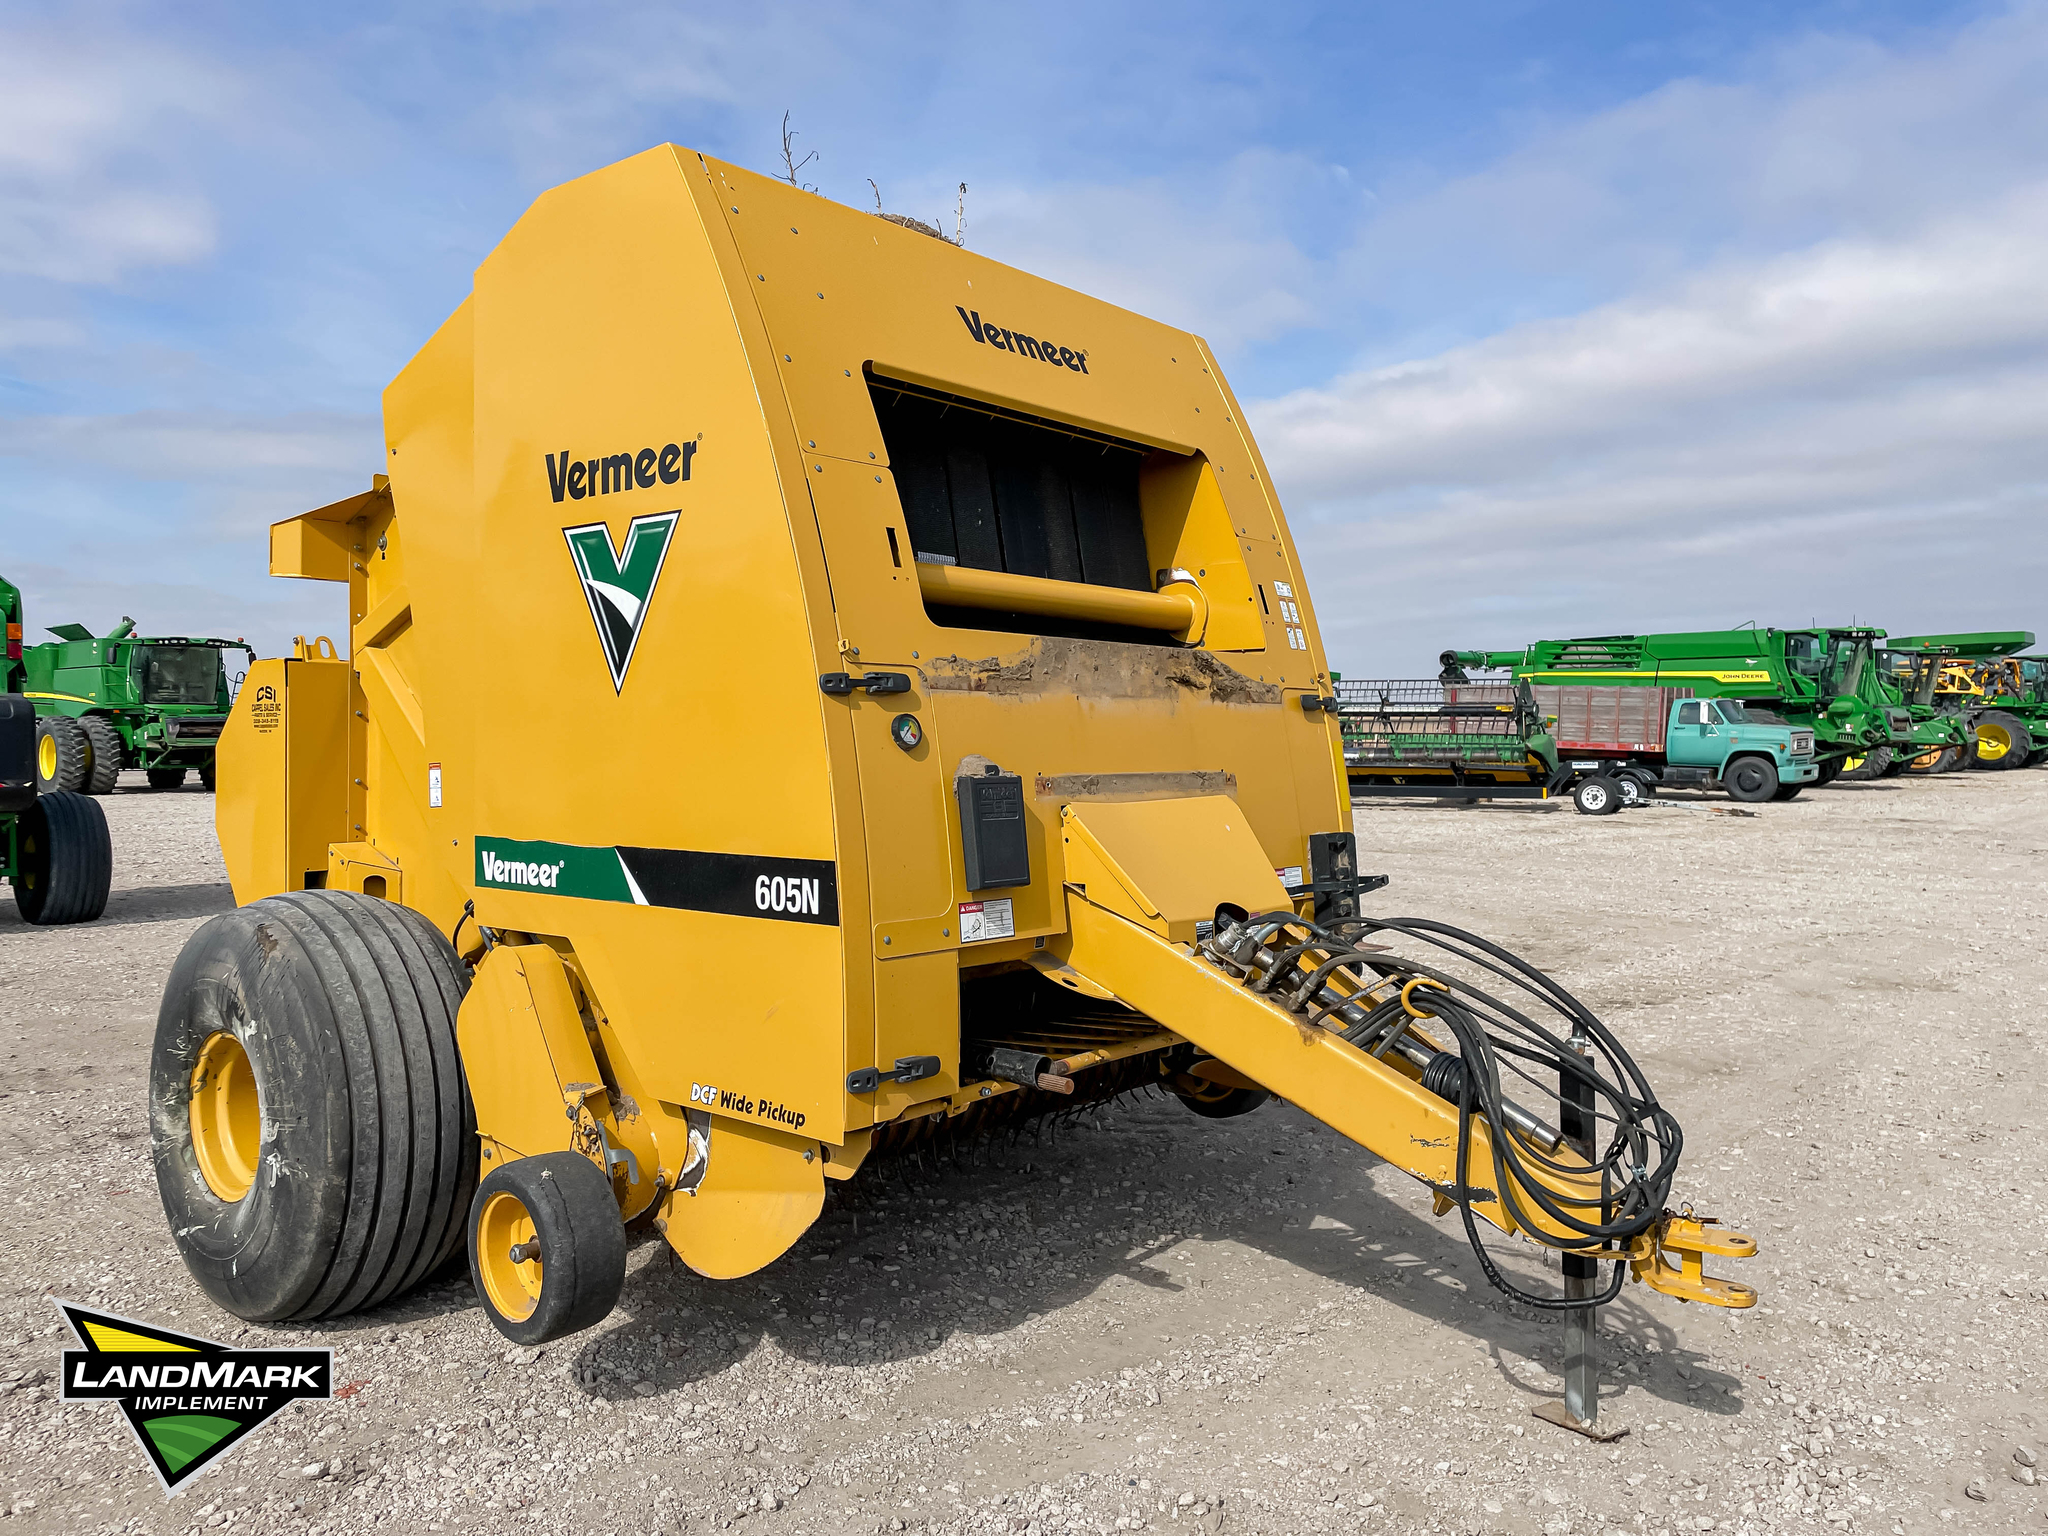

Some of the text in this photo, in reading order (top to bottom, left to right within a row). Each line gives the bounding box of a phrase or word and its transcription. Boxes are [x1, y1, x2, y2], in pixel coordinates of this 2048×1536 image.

[955, 305, 1089, 375] Vermeer
[545, 438, 698, 504] Vermeer
[256, 686, 276, 703] CSI
[264, 703, 274, 712] SALES
[482, 851, 560, 888] Vermeer
[755, 874, 819, 915] 605N
[690, 1082, 806, 1130] DCF Wide Pickup
